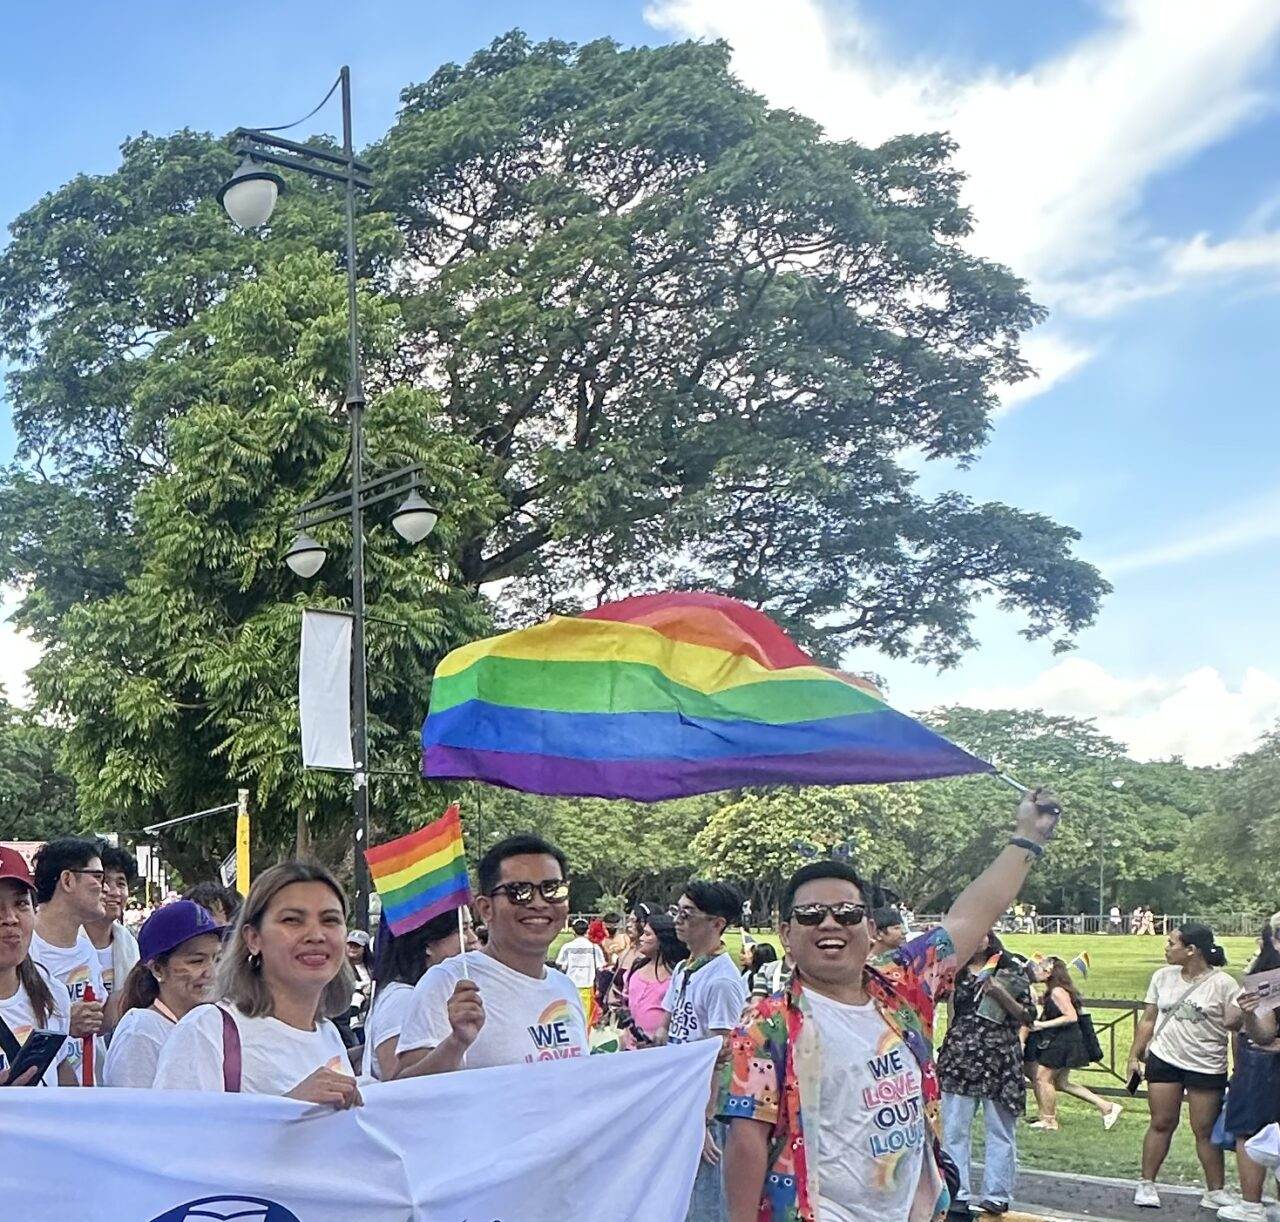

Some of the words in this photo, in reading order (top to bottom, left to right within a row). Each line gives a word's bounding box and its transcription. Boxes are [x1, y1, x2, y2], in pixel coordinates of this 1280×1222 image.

[527, 1022, 570, 1049] WE
[867, 1050, 903, 1080] WE
[863, 1071, 920, 1109] LOVE
[874, 1096, 920, 1130] OUT
[870, 1120, 923, 1157] LOU
